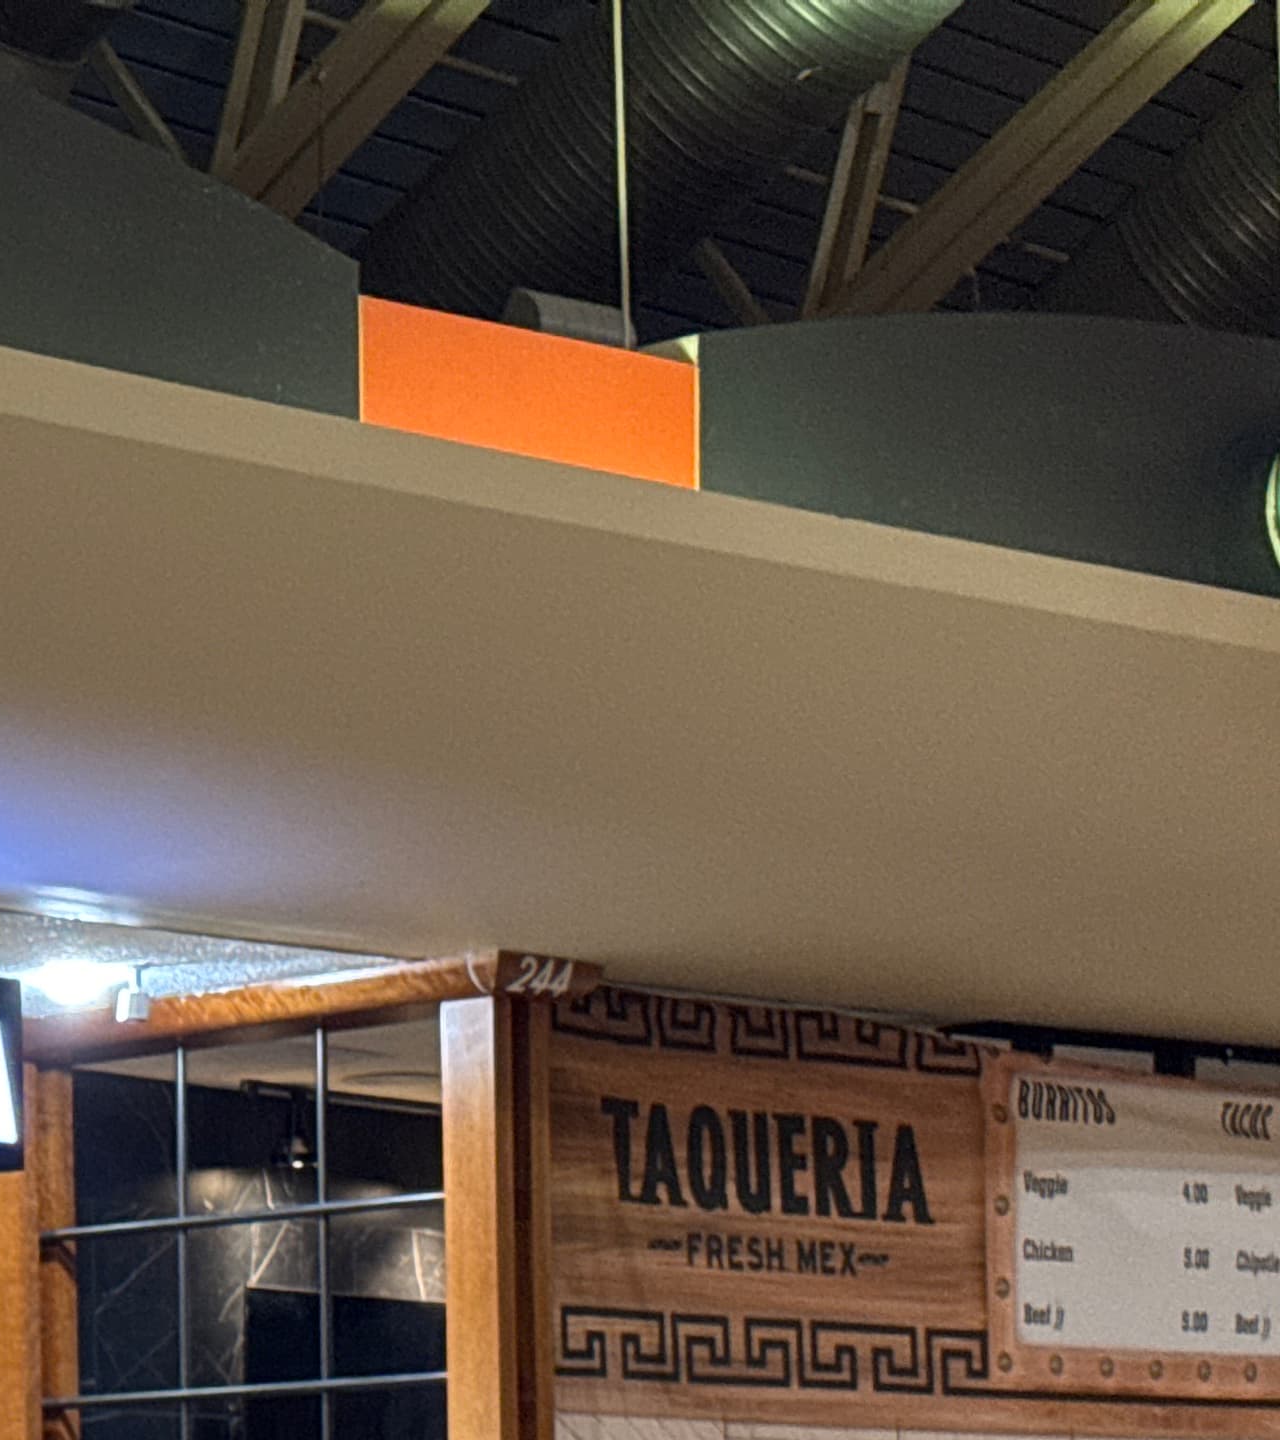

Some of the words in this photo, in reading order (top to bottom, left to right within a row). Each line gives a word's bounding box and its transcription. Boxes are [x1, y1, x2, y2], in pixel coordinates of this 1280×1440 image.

[505, 956, 574, 997] 244
[1018, 1080, 1116, 1125] BURRITOS
[600, 1096, 935, 1225] TAQUERIA
[1023, 1169, 1068, 1198] Veggie
[686, 1232, 785, 1273] FRESH
[796, 1237, 859, 1278] MEX
[1023, 1238, 1074, 1263] Chicken
